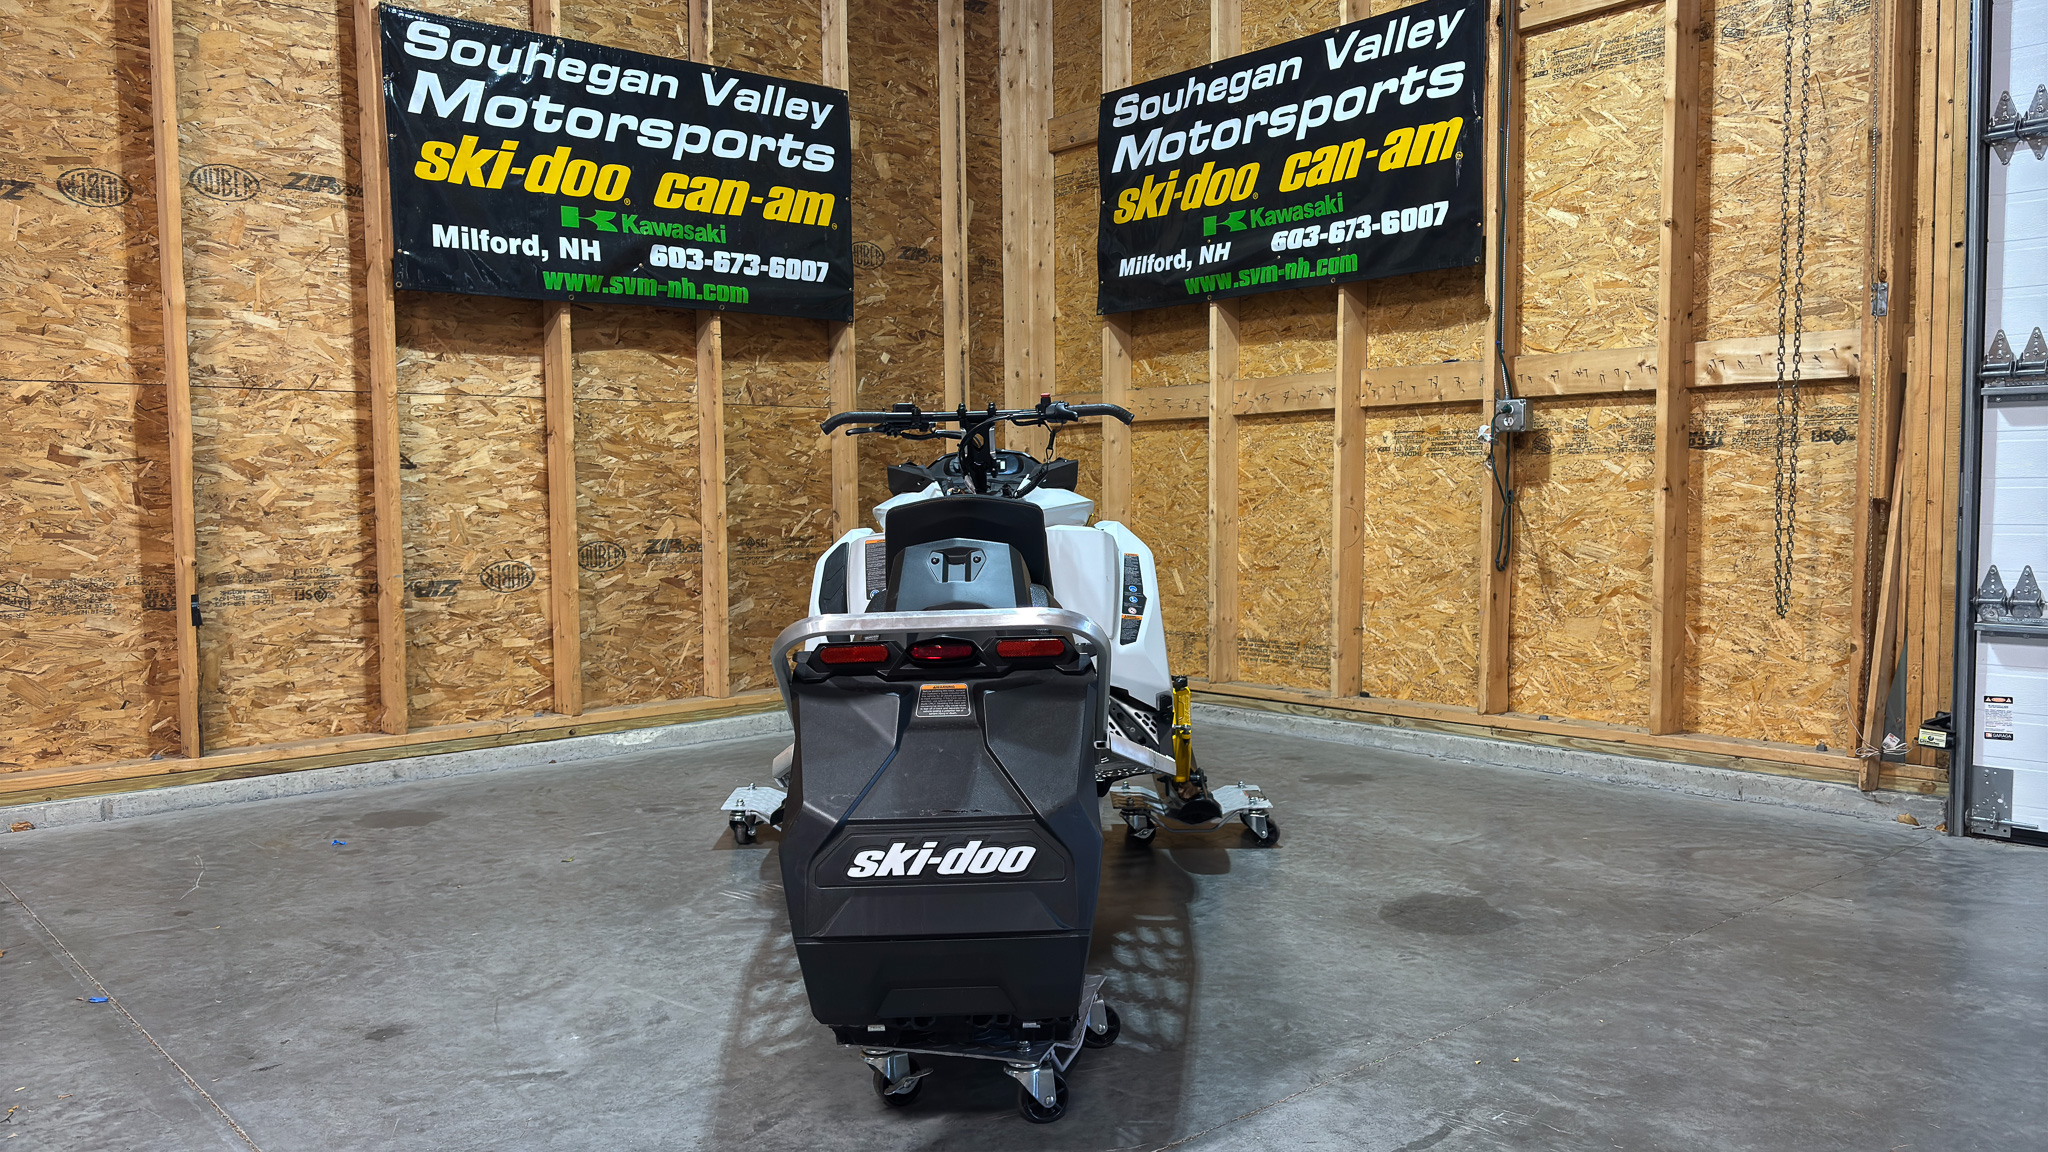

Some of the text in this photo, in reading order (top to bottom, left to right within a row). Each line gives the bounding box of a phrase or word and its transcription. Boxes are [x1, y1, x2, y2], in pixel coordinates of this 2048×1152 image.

[404, 20, 835, 130] Souhegan Valley
[1112, 9, 1466, 128] Souhegan Valley
[408, 70, 836, 173] Motorsports
[1112, 61, 1466, 174] Motorsports
[413, 135, 836, 227] ski-doo can-am
[1114, 161, 1261, 225] ski-doo
[1278, 117, 1464, 193] can-am
[621, 213, 727, 244] Kawasaki
[1250, 192, 1344, 229] Kawasaki
[1271, 201, 1449, 252] 603-673-6007
[433, 224, 602, 263] Milford, NH
[650, 244, 829, 283] 603-673-6007
[1119, 242, 1232, 278] Milford, NH
[543, 271, 750, 304] www.svm-nh.com
[1185, 254, 1358, 295] www.svm-nh.com
[580, 543, 622, 569] HUBER
[293, 589, 314, 602] SFI
[846, 839, 1038, 879] ski-doo
